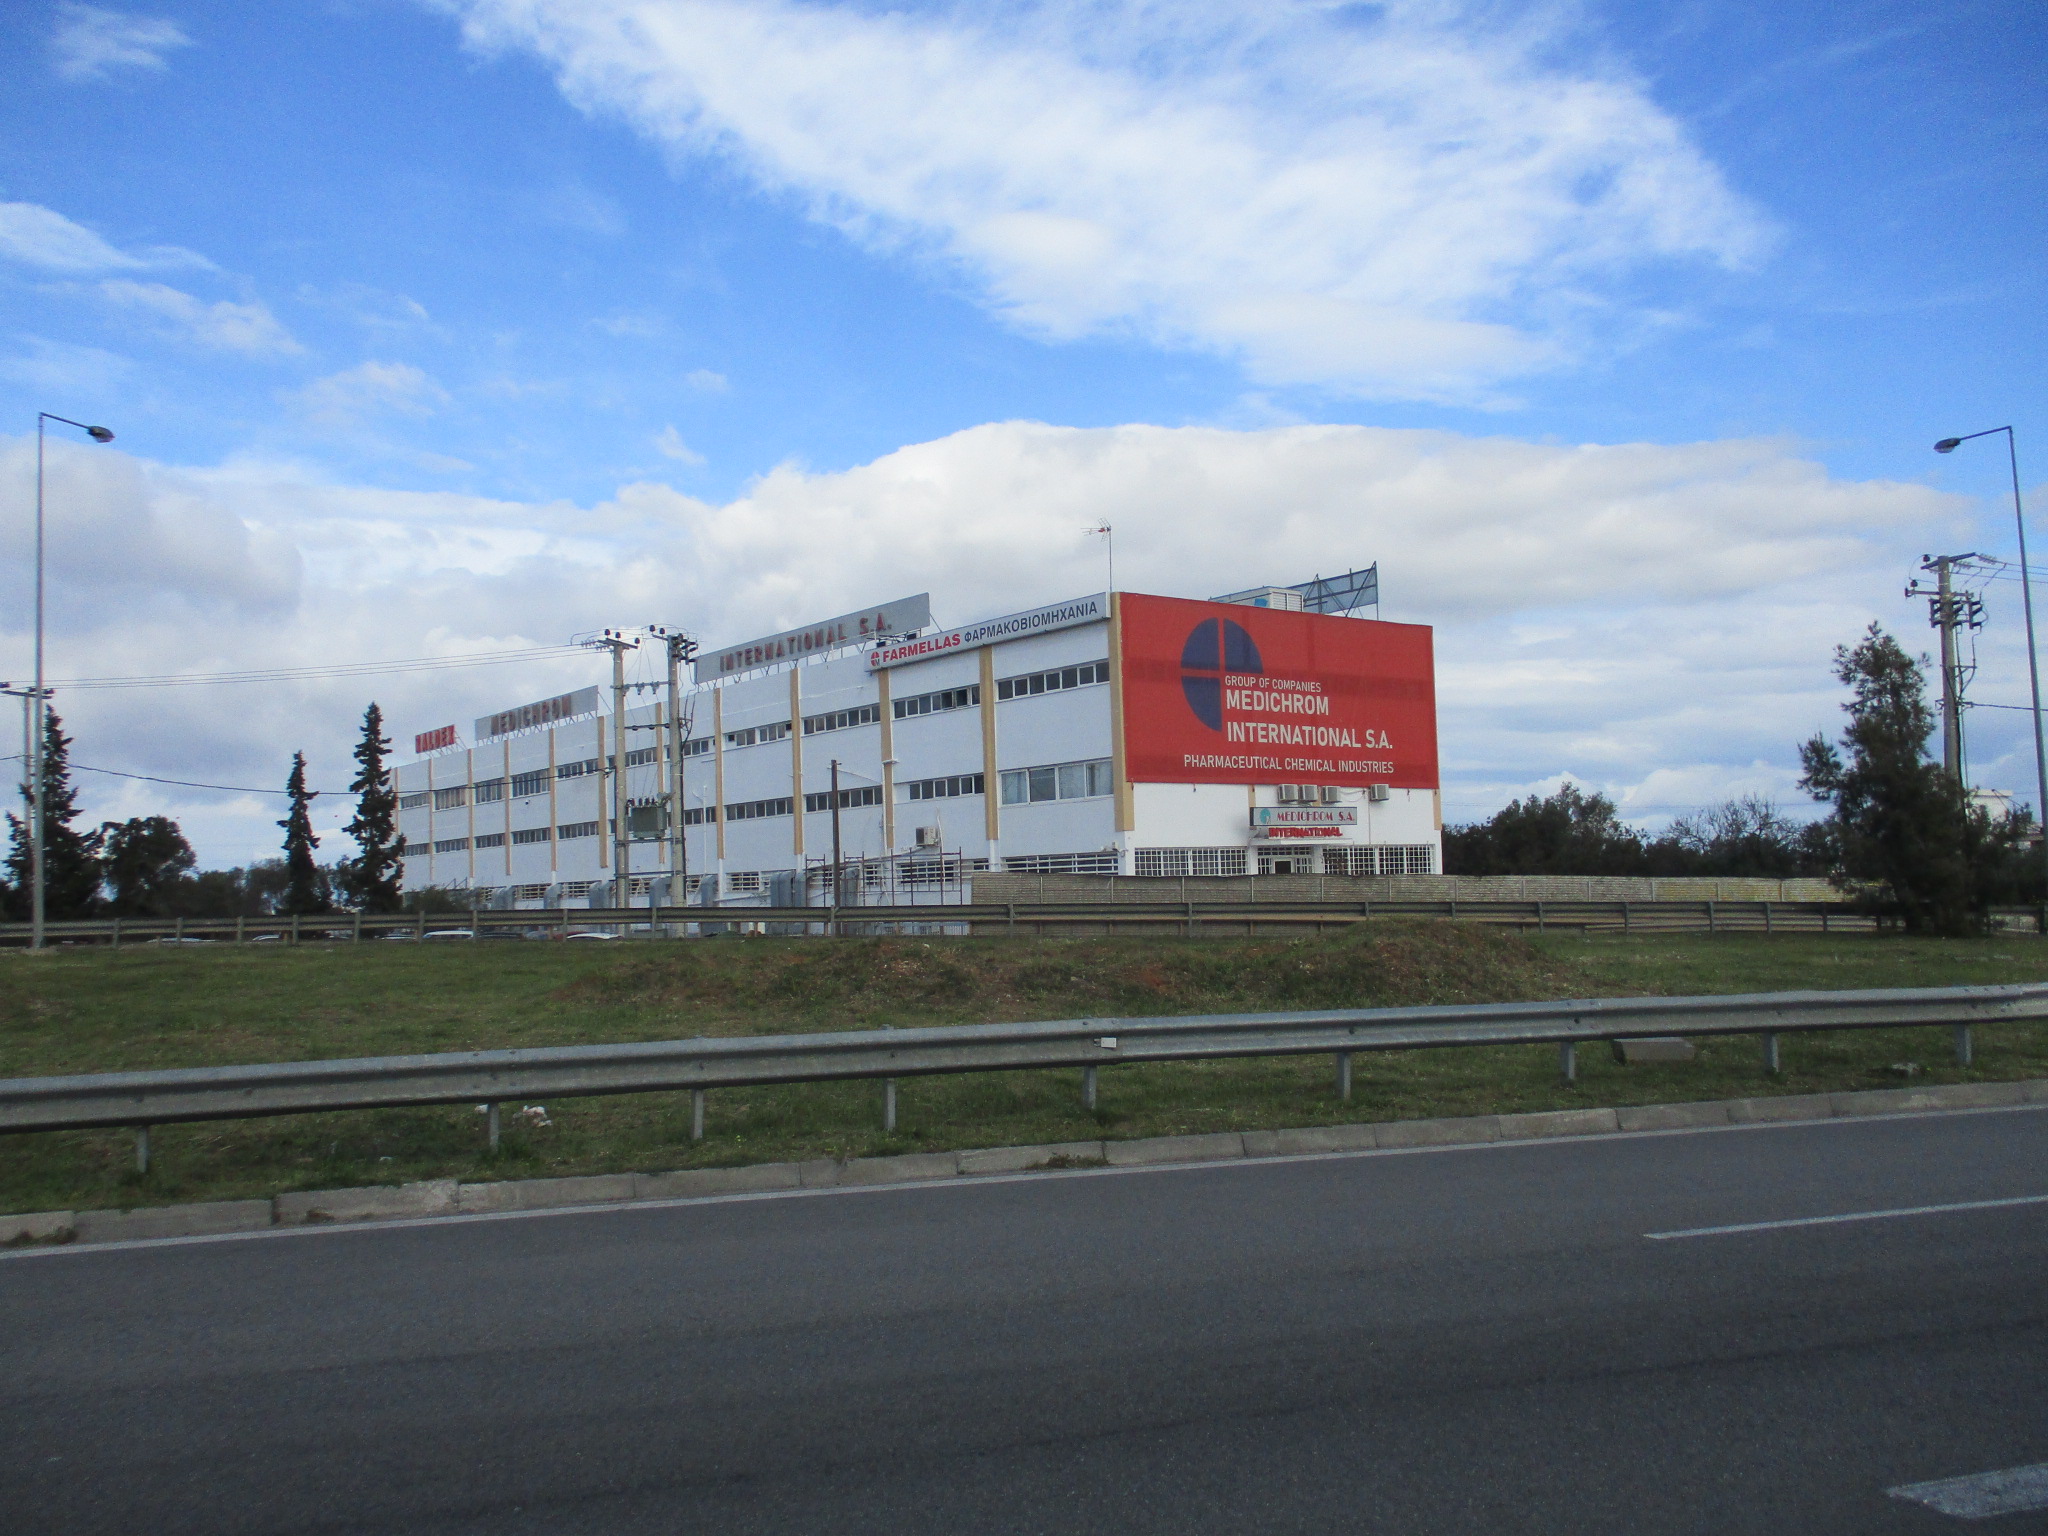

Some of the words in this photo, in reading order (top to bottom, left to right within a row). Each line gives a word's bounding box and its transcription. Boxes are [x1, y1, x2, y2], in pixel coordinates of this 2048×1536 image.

[719, 623, 847, 672] INTERNATIONAL
[859, 612, 892, 635] S.A.
[882, 633, 961, 663] FARMELLAS
[964, 601, 1098, 643] ΦΑΡΜΑΚΟΒΙΟΜΗΧΑΝΙΑ
[1225, 675, 1256, 687] GROUP
[1258, 677, 1270, 688] OF
[1272, 679, 1321, 693] COMPANIES
[1226, 689, 1329, 716] MEDICHROM
[1227, 721, 1362, 748] INTERNATIONAL
[1365, 729, 1393, 749] S.A.
[1184, 754, 1282, 770] PHARMACEUTICAL
[1284, 758, 1336, 772] CHEMICAL
[1338, 760, 1395, 774] INDUSTRIES
[1277, 811, 1333, 821] MEDICHROM
[1338, 811, 1355, 821] S.A.
[1268, 827, 1343, 837] INTERNATIONAL
